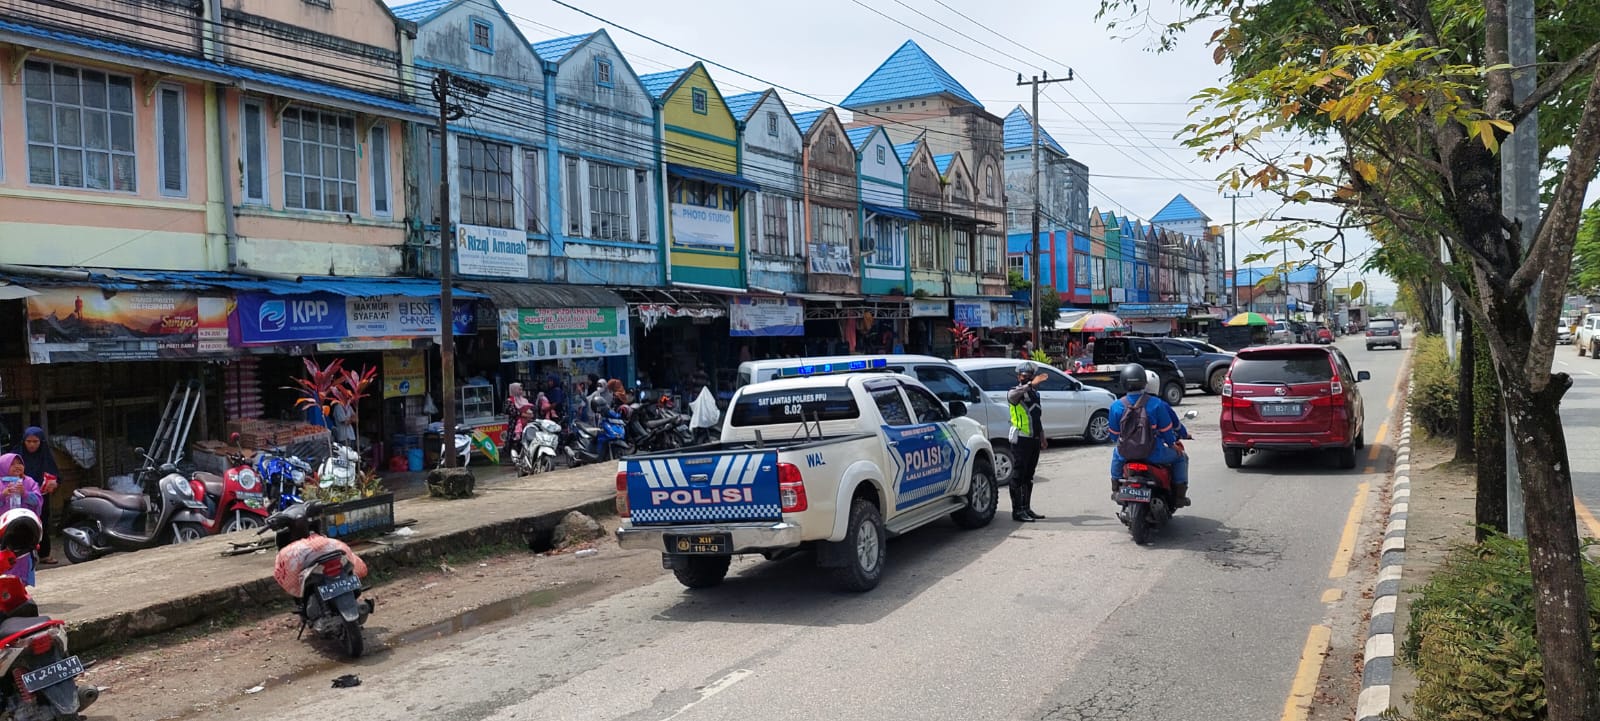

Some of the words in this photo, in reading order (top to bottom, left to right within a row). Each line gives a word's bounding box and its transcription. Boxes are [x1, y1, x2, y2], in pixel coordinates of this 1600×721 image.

[682, 208, 706, 221] PHOTO
[708, 211, 731, 224] STUDIO
[467, 234, 489, 255] Rizqi
[492, 237, 527, 255] Amanah
[292, 300, 329, 323] KPP
[353, 302, 389, 311] MAKMUR
[410, 302, 435, 315] ESSE
[353, 311, 390, 321] SYAFA'AT
[399, 316, 436, 326] CHANGE
[758, 398, 770, 406] SAT
[770, 396, 791, 405] LANTAS
[792, 394, 814, 404] POLRES
[815, 393, 827, 401] PPU
[784, 404, 802, 415] 8.02
[905, 446, 941, 473] POLISI
[906, 472, 921, 480] LALU
[922, 466, 942, 476] LINTAS
[650, 487, 753, 506] POLISI
[24, 673, 36, 684] KT
[38, 663, 63, 681] 2478
[66, 658, 77, 668] VT
